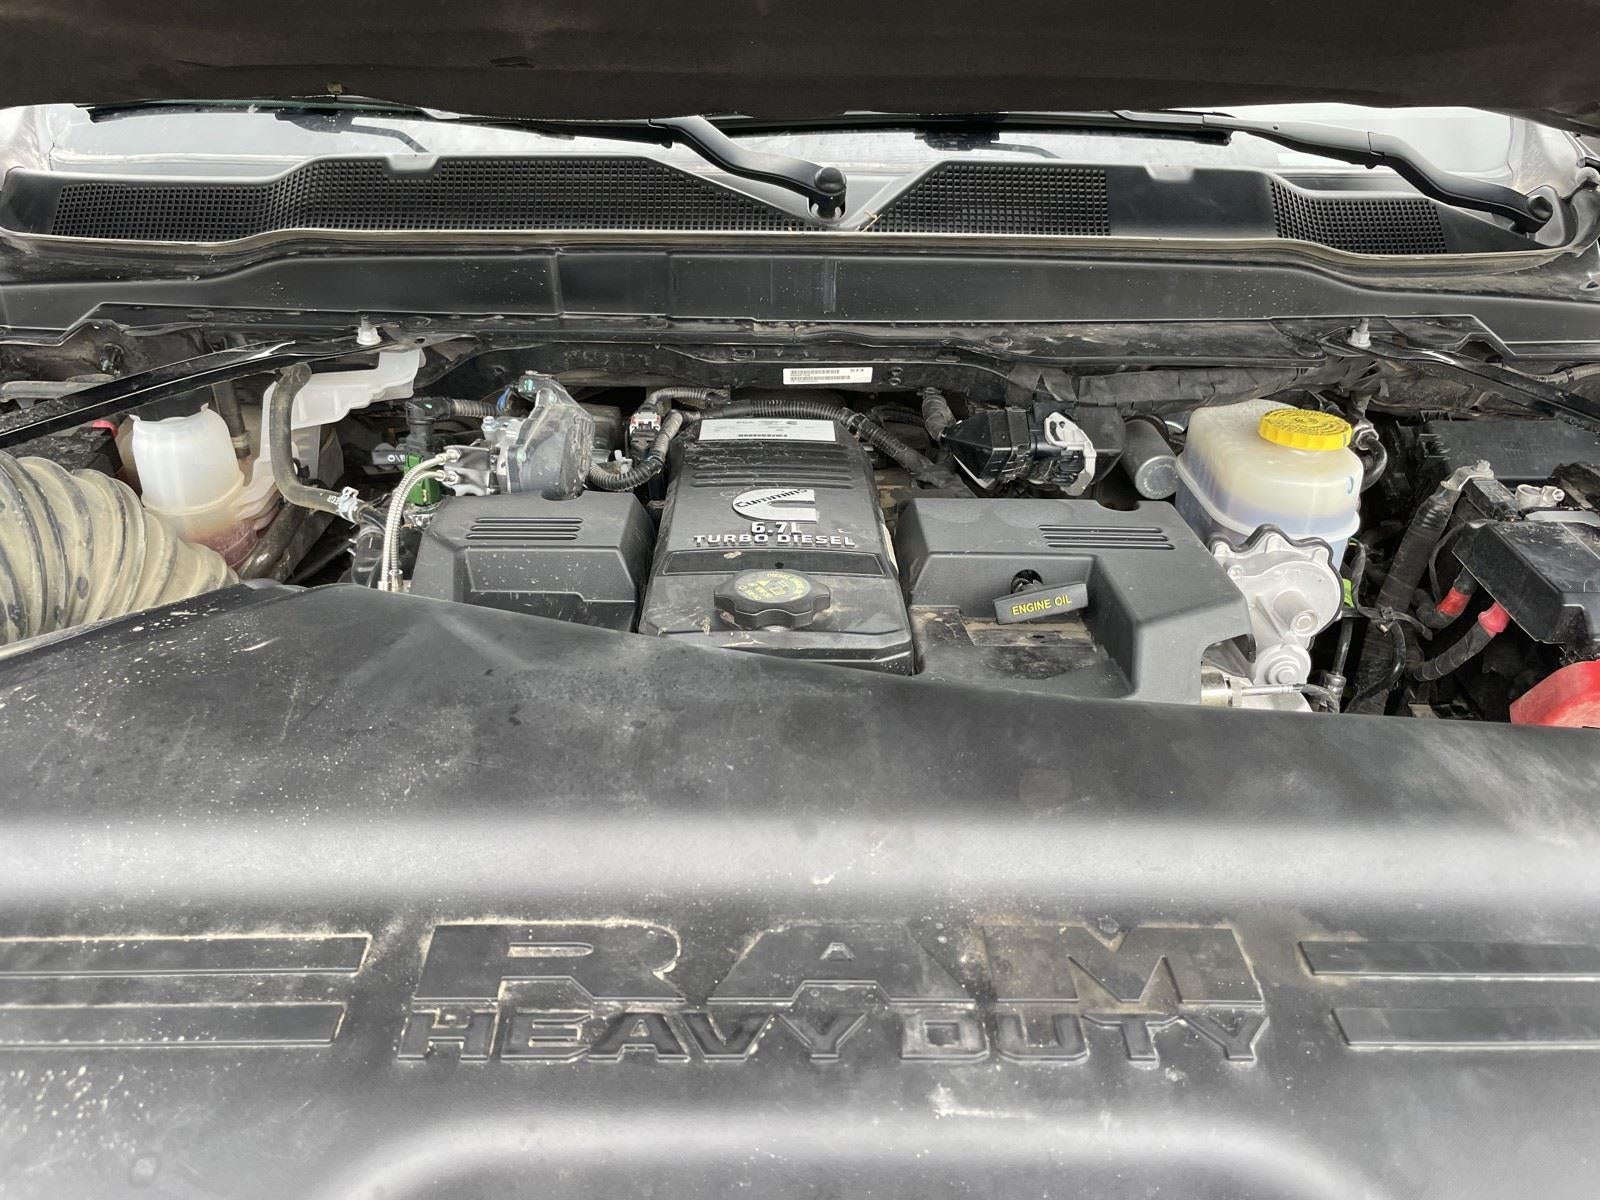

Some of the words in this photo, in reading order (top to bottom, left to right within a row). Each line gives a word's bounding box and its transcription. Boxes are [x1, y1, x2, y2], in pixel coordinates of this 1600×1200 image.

[751, 521, 802, 536] 6.7L
[693, 534, 769, 547] TURBO
[777, 534, 857, 547] DIESEL
[1011, 598, 1051, 616] ENGINE
[1054, 594, 1073, 607] OIL
[412, 921, 1266, 1008] RAM
[397, 1009, 868, 1063] HEAVY
[901, 1011, 1270, 1065] DUTY
